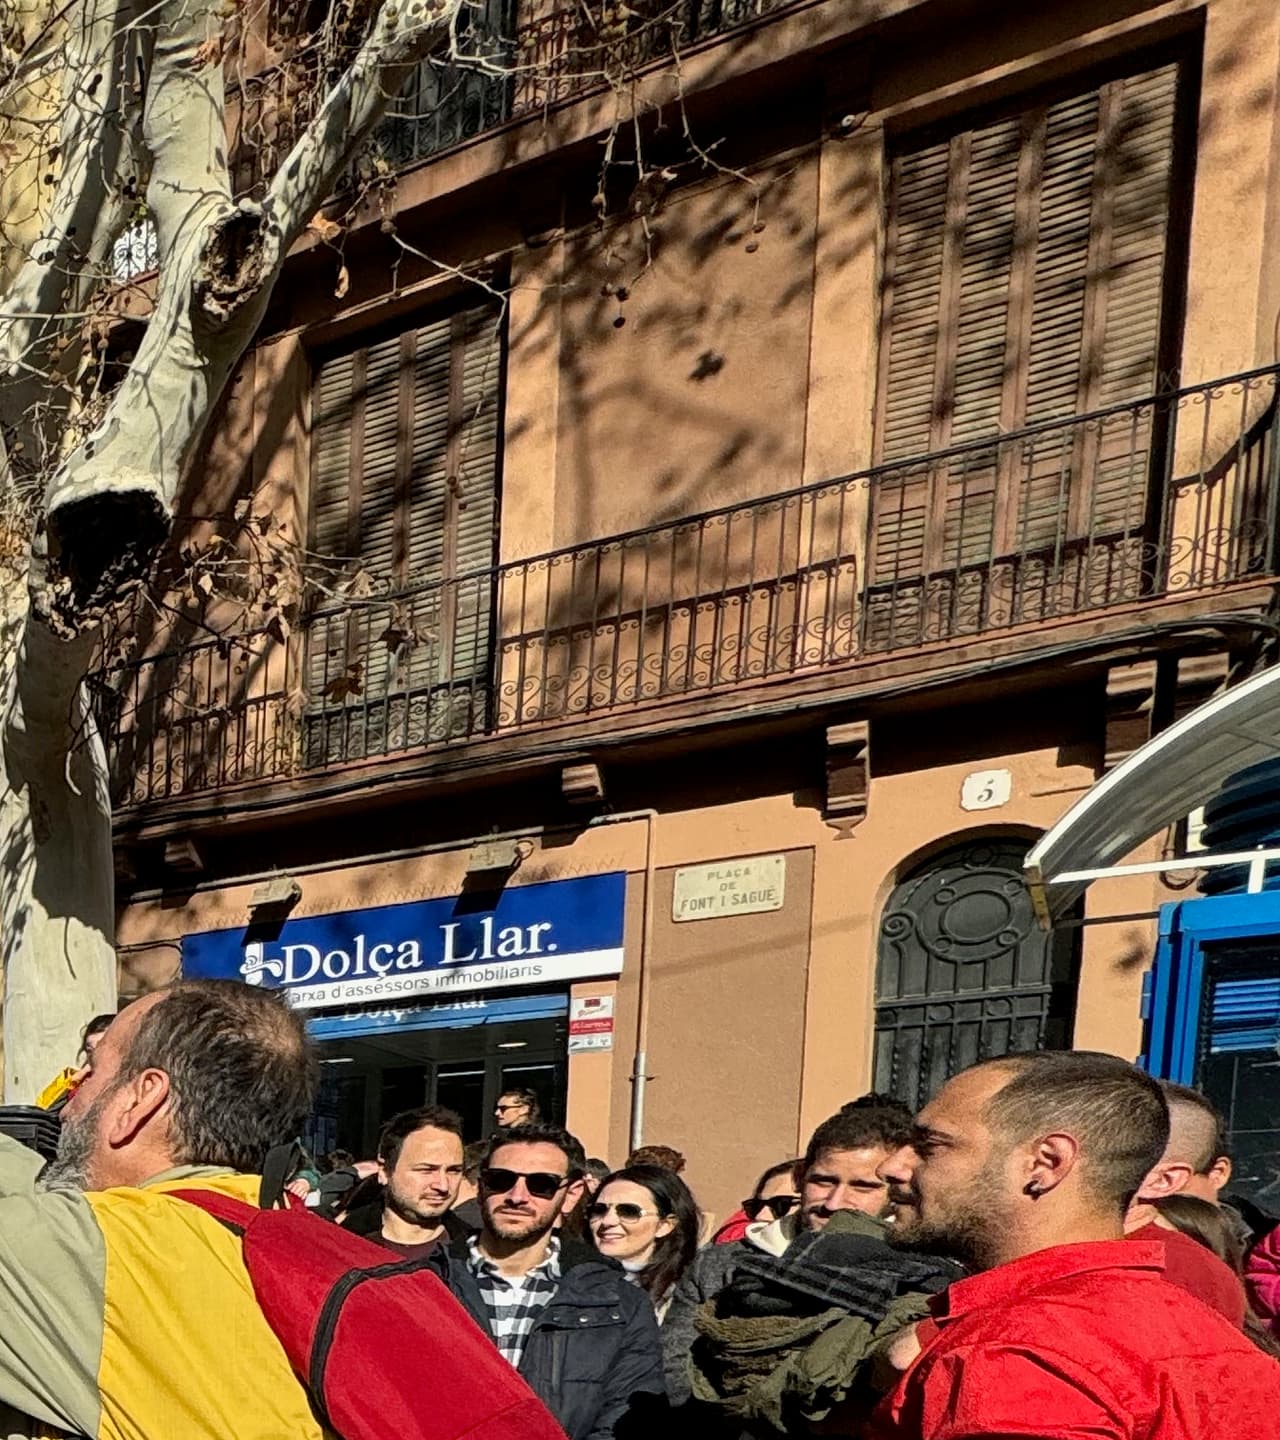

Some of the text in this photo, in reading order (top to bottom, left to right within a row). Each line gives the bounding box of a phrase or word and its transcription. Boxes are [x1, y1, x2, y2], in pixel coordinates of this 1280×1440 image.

[977, 778, 994, 802] 5
[720, 882, 737, 892] DE
[681, 896, 715, 912] FONT
[281, 934, 423, 982] Dolça
[288, 965, 544, 1004] arxa d'assessors immobiliaris
